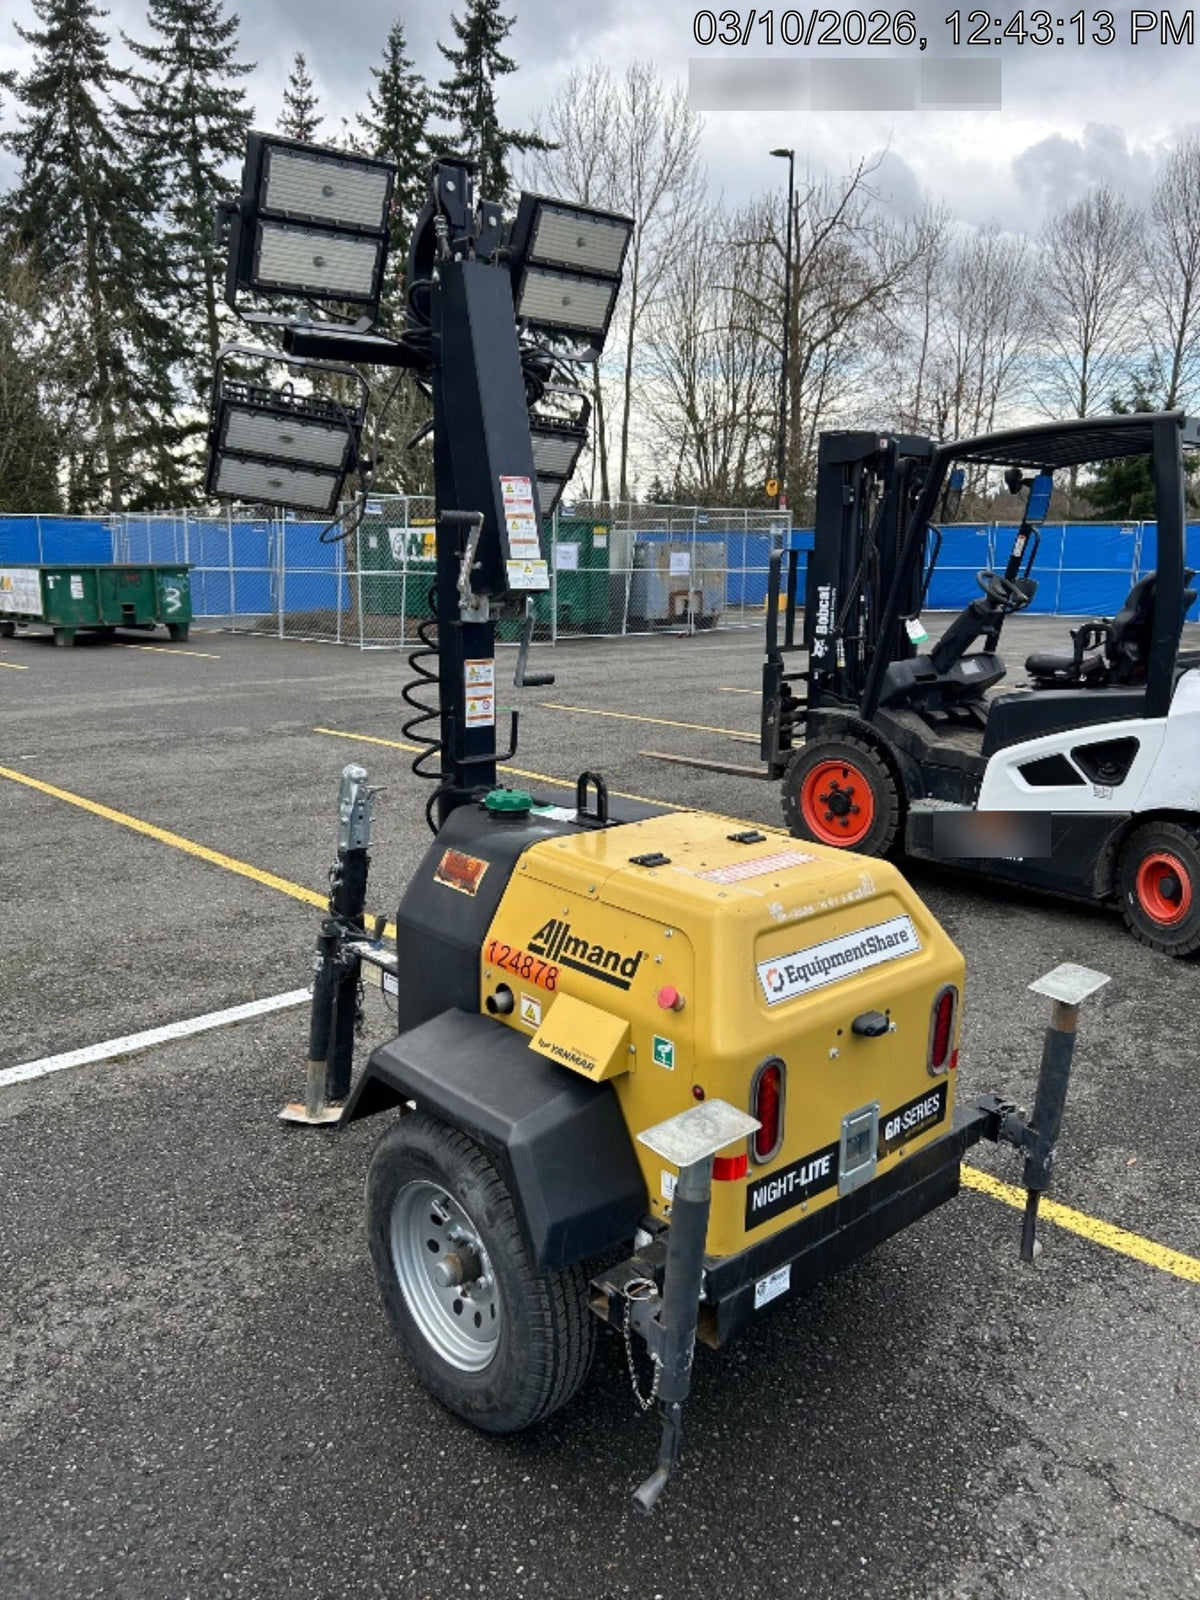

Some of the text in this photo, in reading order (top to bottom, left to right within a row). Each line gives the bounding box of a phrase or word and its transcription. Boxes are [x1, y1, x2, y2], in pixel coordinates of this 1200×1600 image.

[165, 587, 182, 614] 3
[815, 586, 830, 634] Bobcat
[488, 939, 560, 992] 124878
[531, 918, 644, 979] Allmand
[784, 927, 910, 984] EquipmentShare
[550, 1043, 596, 1073] YANMAR
[884, 1092, 940, 1141] GR-SERIES
[752, 1154, 831, 1212] NIGHT-LITE
